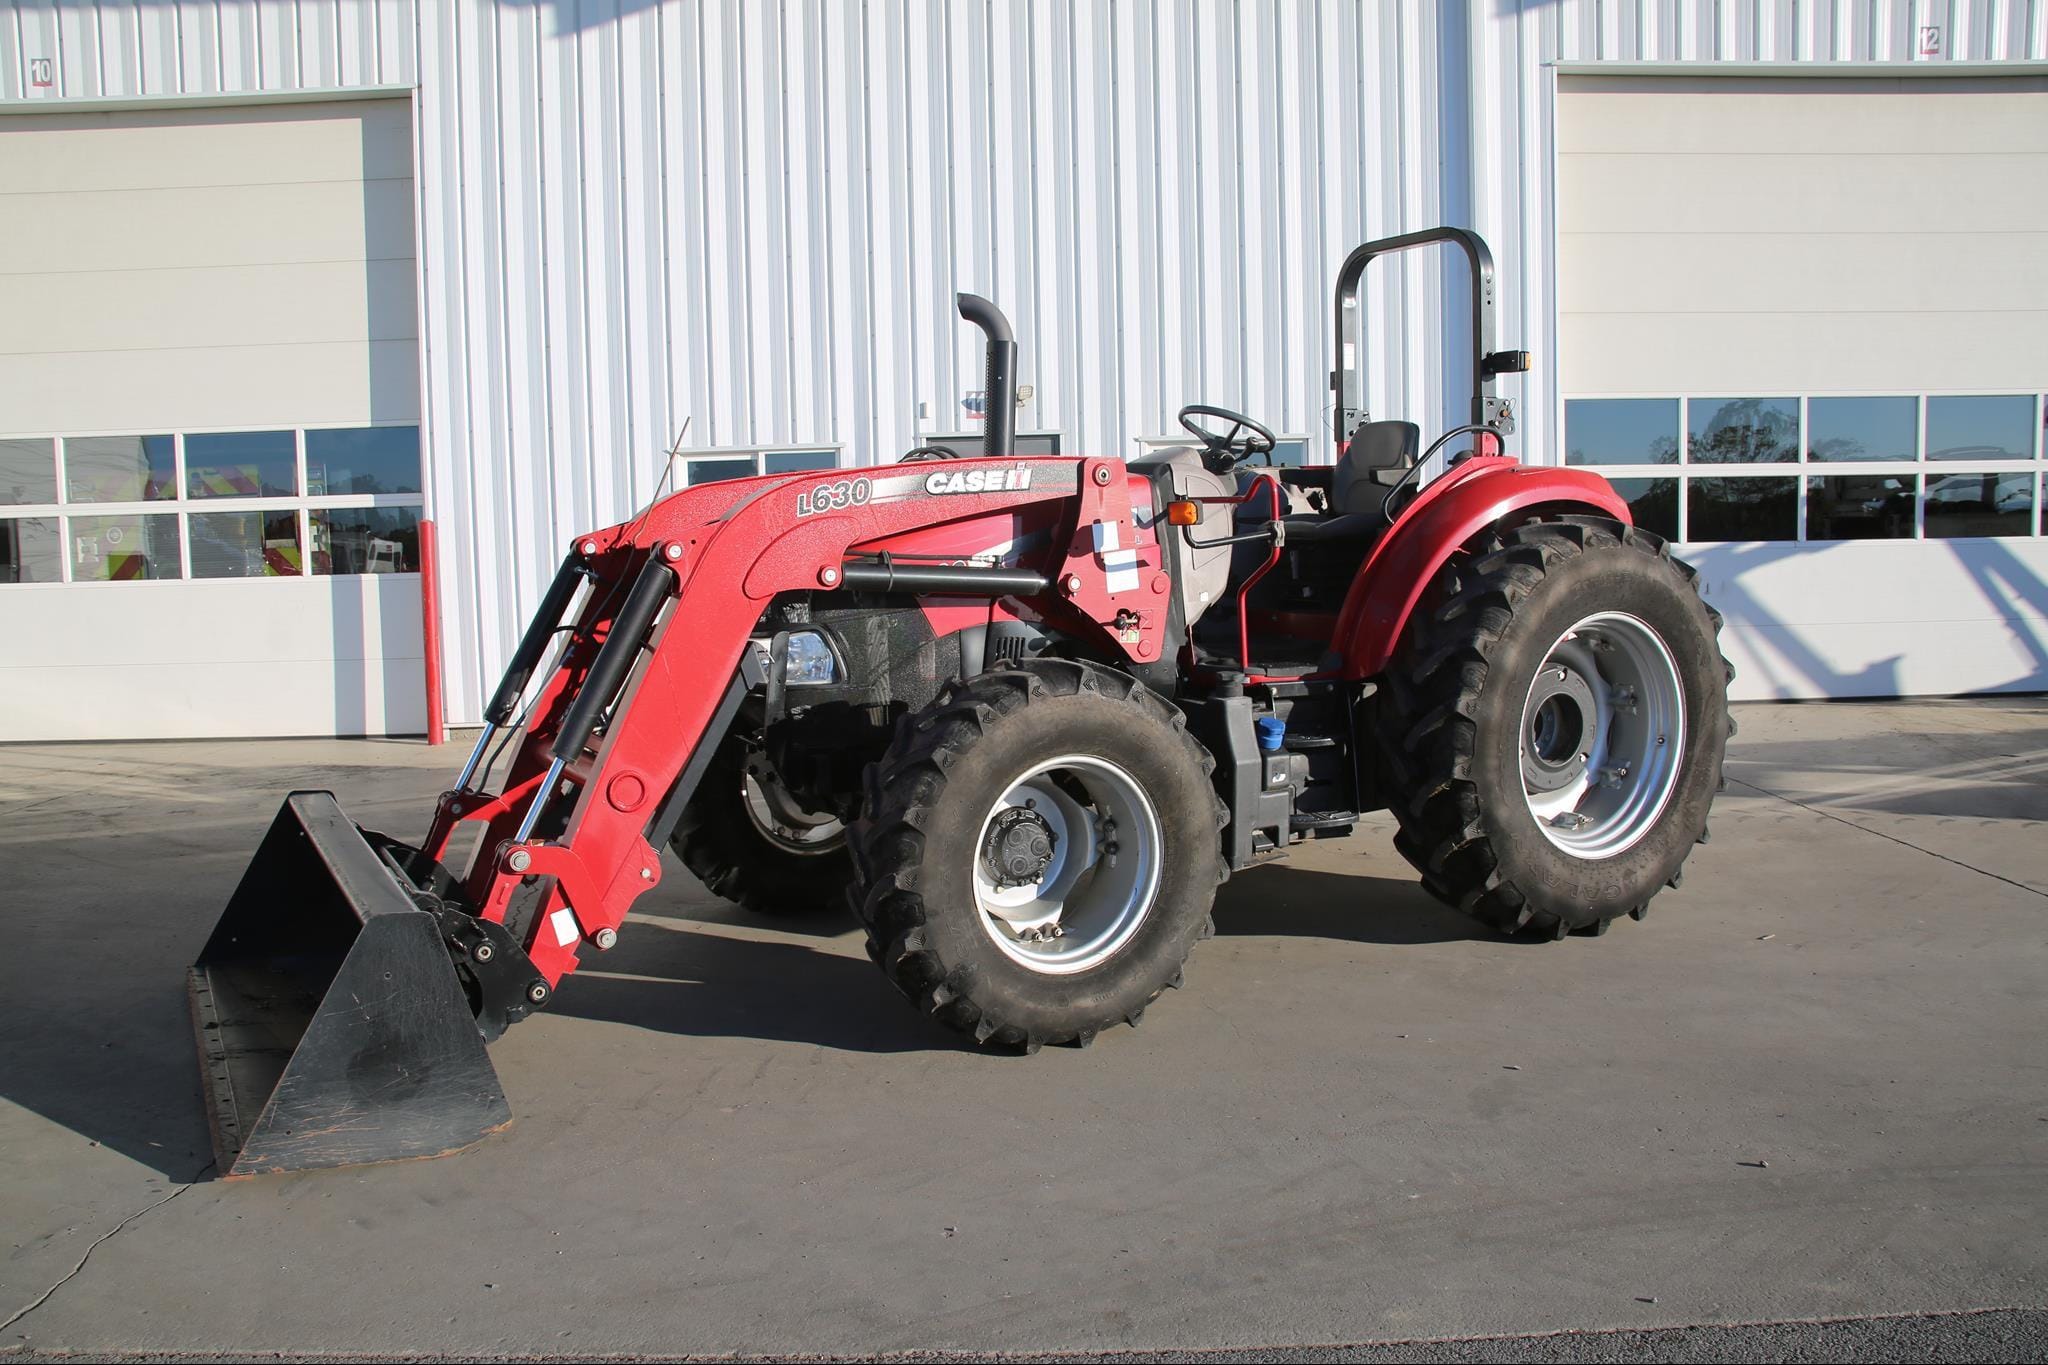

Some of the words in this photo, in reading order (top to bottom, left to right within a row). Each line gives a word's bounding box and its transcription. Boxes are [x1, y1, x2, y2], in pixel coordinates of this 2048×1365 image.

[1921, 28, 1938, 50] 12
[32, 60, 51, 82] 10
[925, 470, 1004, 495] CASE
[797, 477, 872, 517] L630
